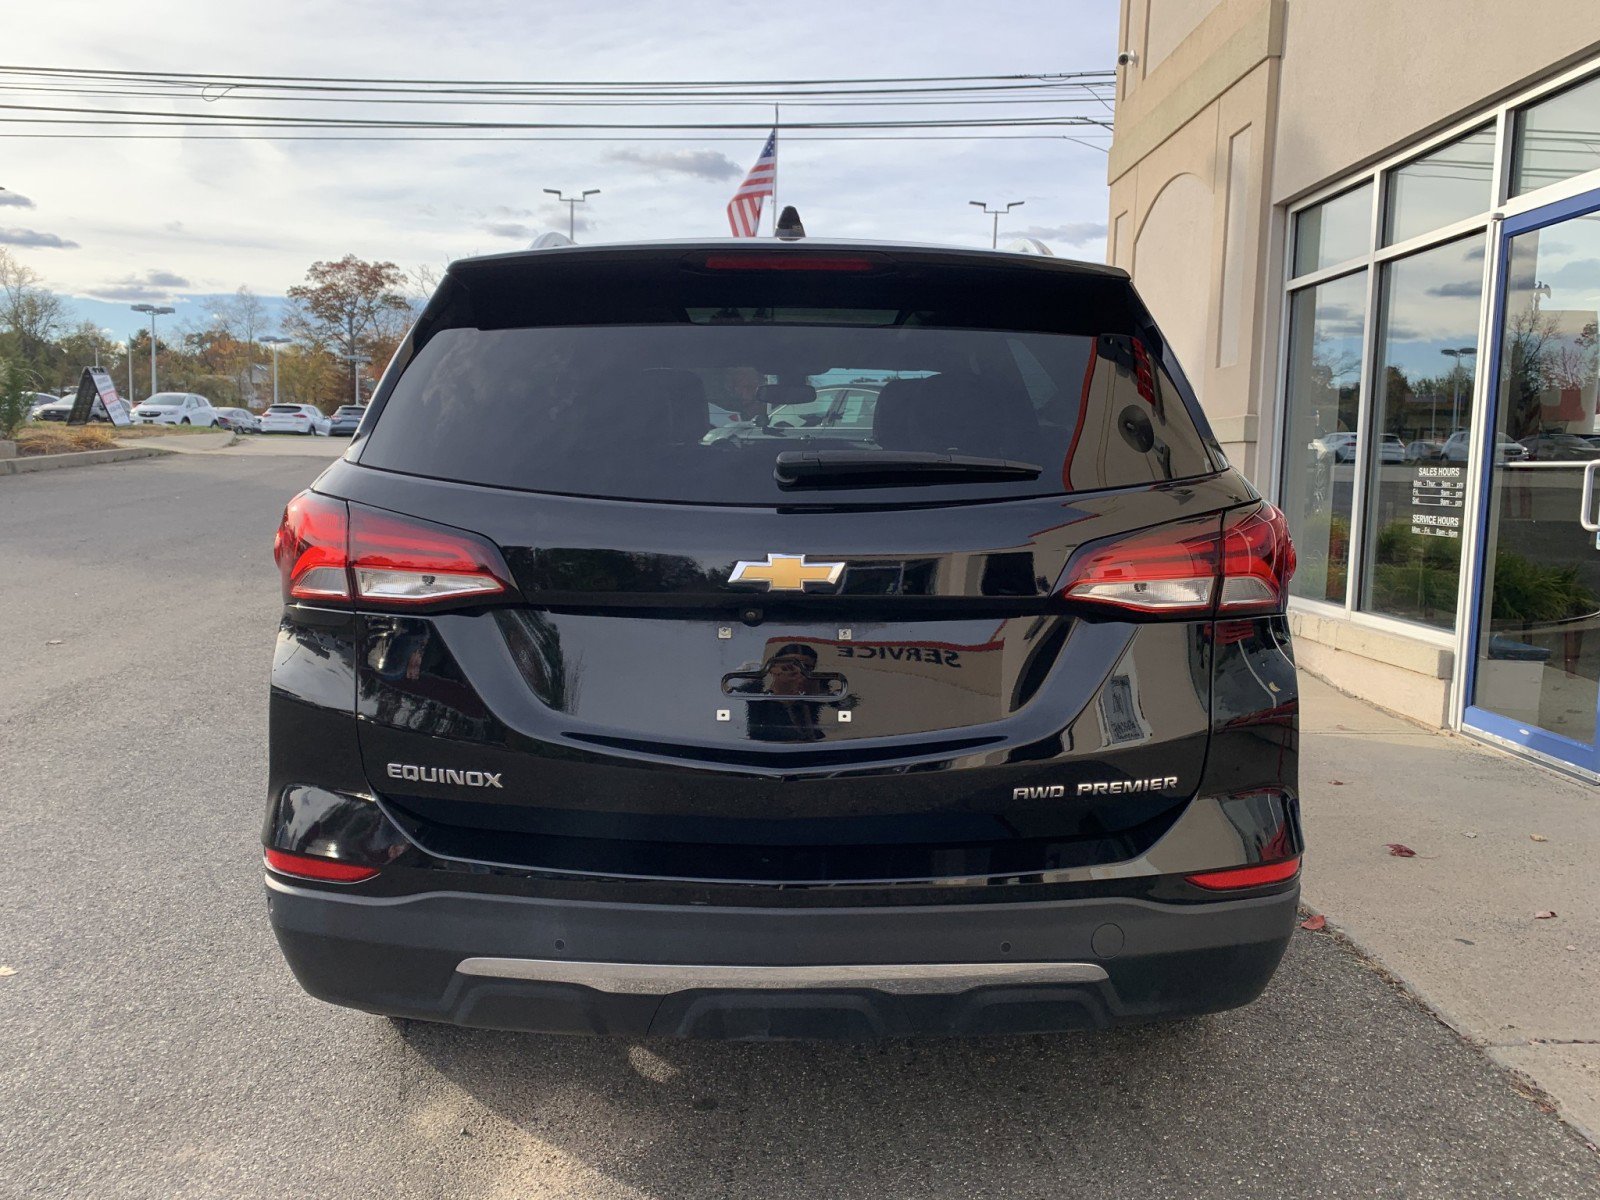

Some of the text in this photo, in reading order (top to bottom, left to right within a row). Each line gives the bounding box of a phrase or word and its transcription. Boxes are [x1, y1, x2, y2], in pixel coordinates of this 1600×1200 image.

[1418, 467, 1460, 477] SALES HOURS
[1412, 514, 1459, 526] SERVICE HOURS
[387, 763, 503, 788] EQUINOX
[1012, 776, 1178, 800] AWD PREMIER
